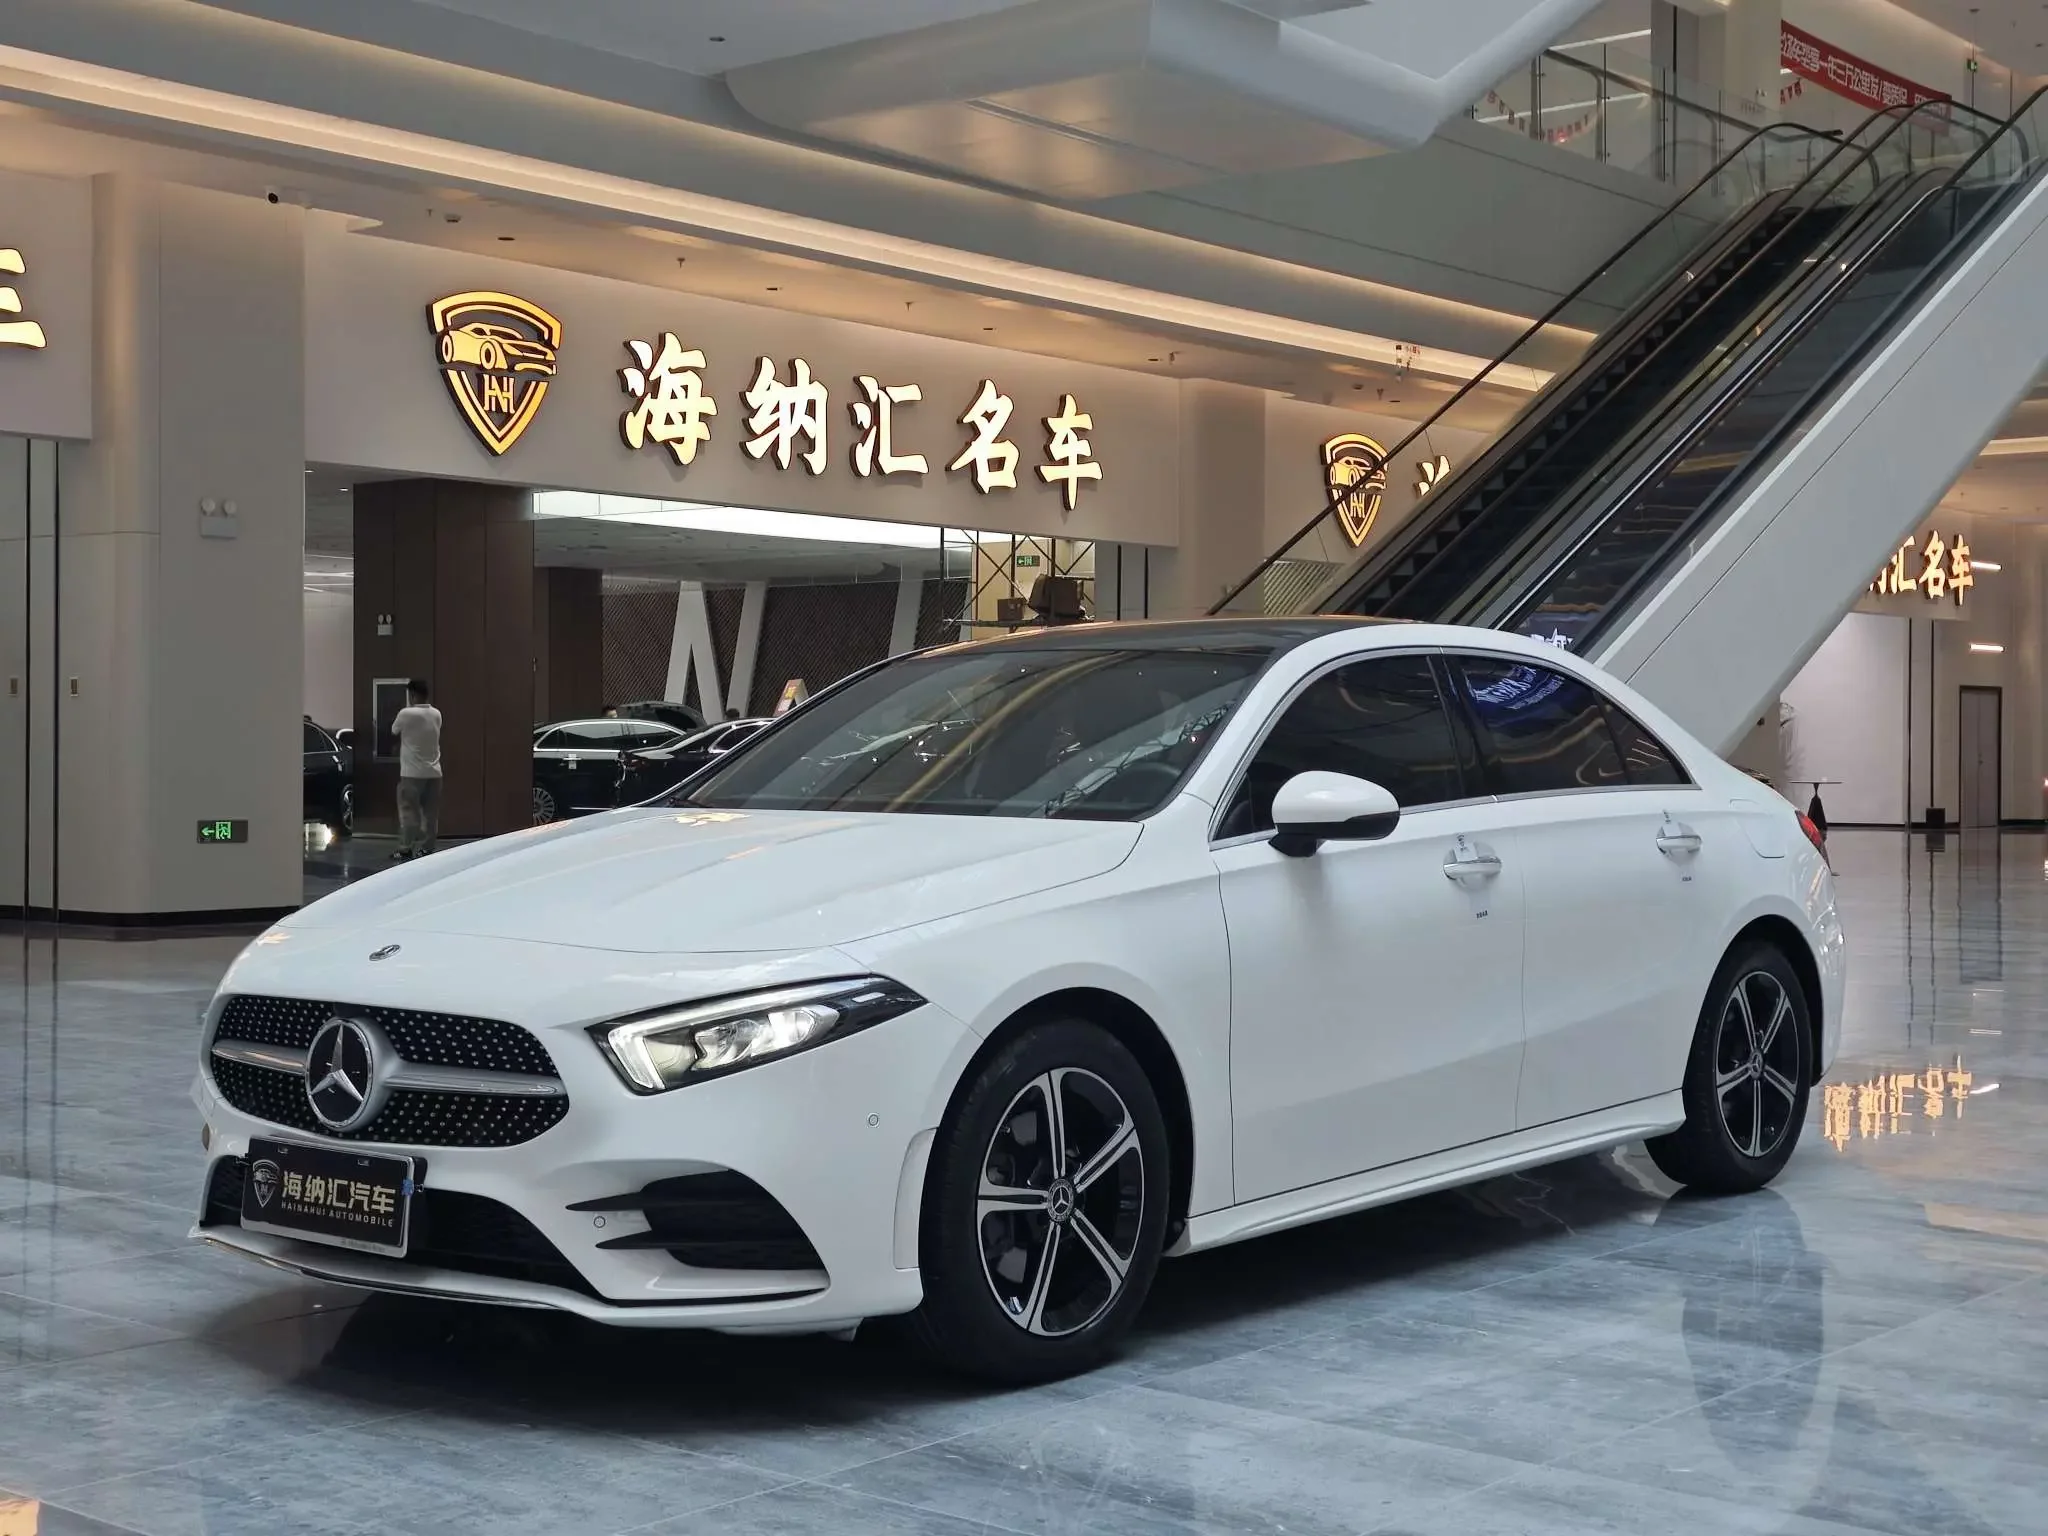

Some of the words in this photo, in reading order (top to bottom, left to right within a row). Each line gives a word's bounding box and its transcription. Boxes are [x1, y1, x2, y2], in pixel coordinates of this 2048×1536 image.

[616, 330, 1104, 511] 海纳汇名车
[281, 1169, 396, 1214] 海纳汇汽车
[281, 1200, 326, 1216] HAINAHUI
[328, 1208, 394, 1228] AUTOMOBILE
